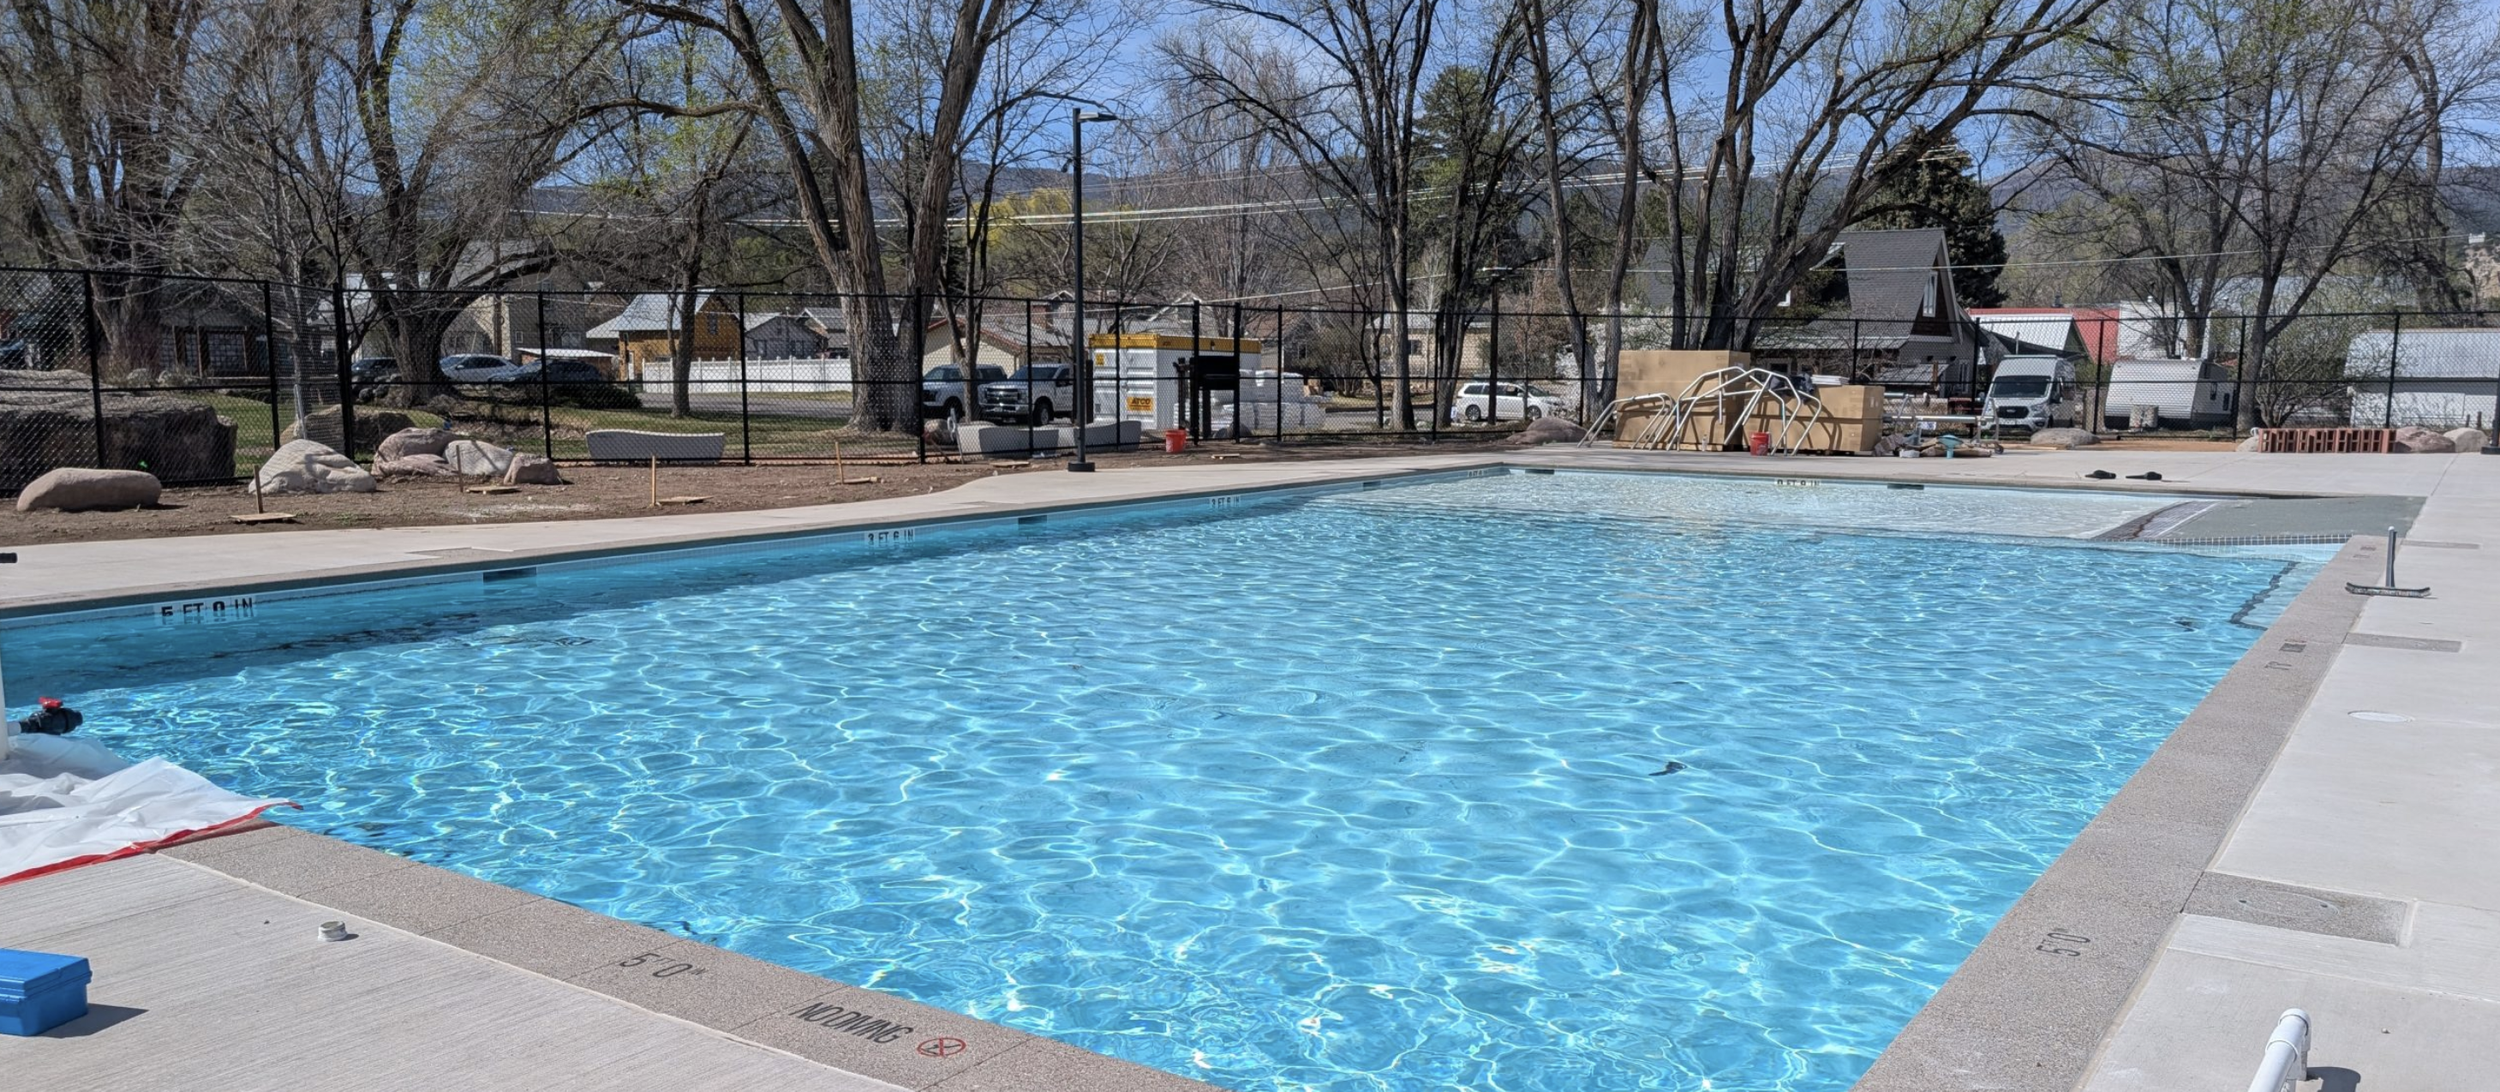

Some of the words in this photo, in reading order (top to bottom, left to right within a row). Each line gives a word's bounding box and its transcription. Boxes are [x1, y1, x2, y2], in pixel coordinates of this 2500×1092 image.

[879, 531, 890, 540] FT
[182, 602, 204, 615] FT
[234, 597, 253, 610] IN
